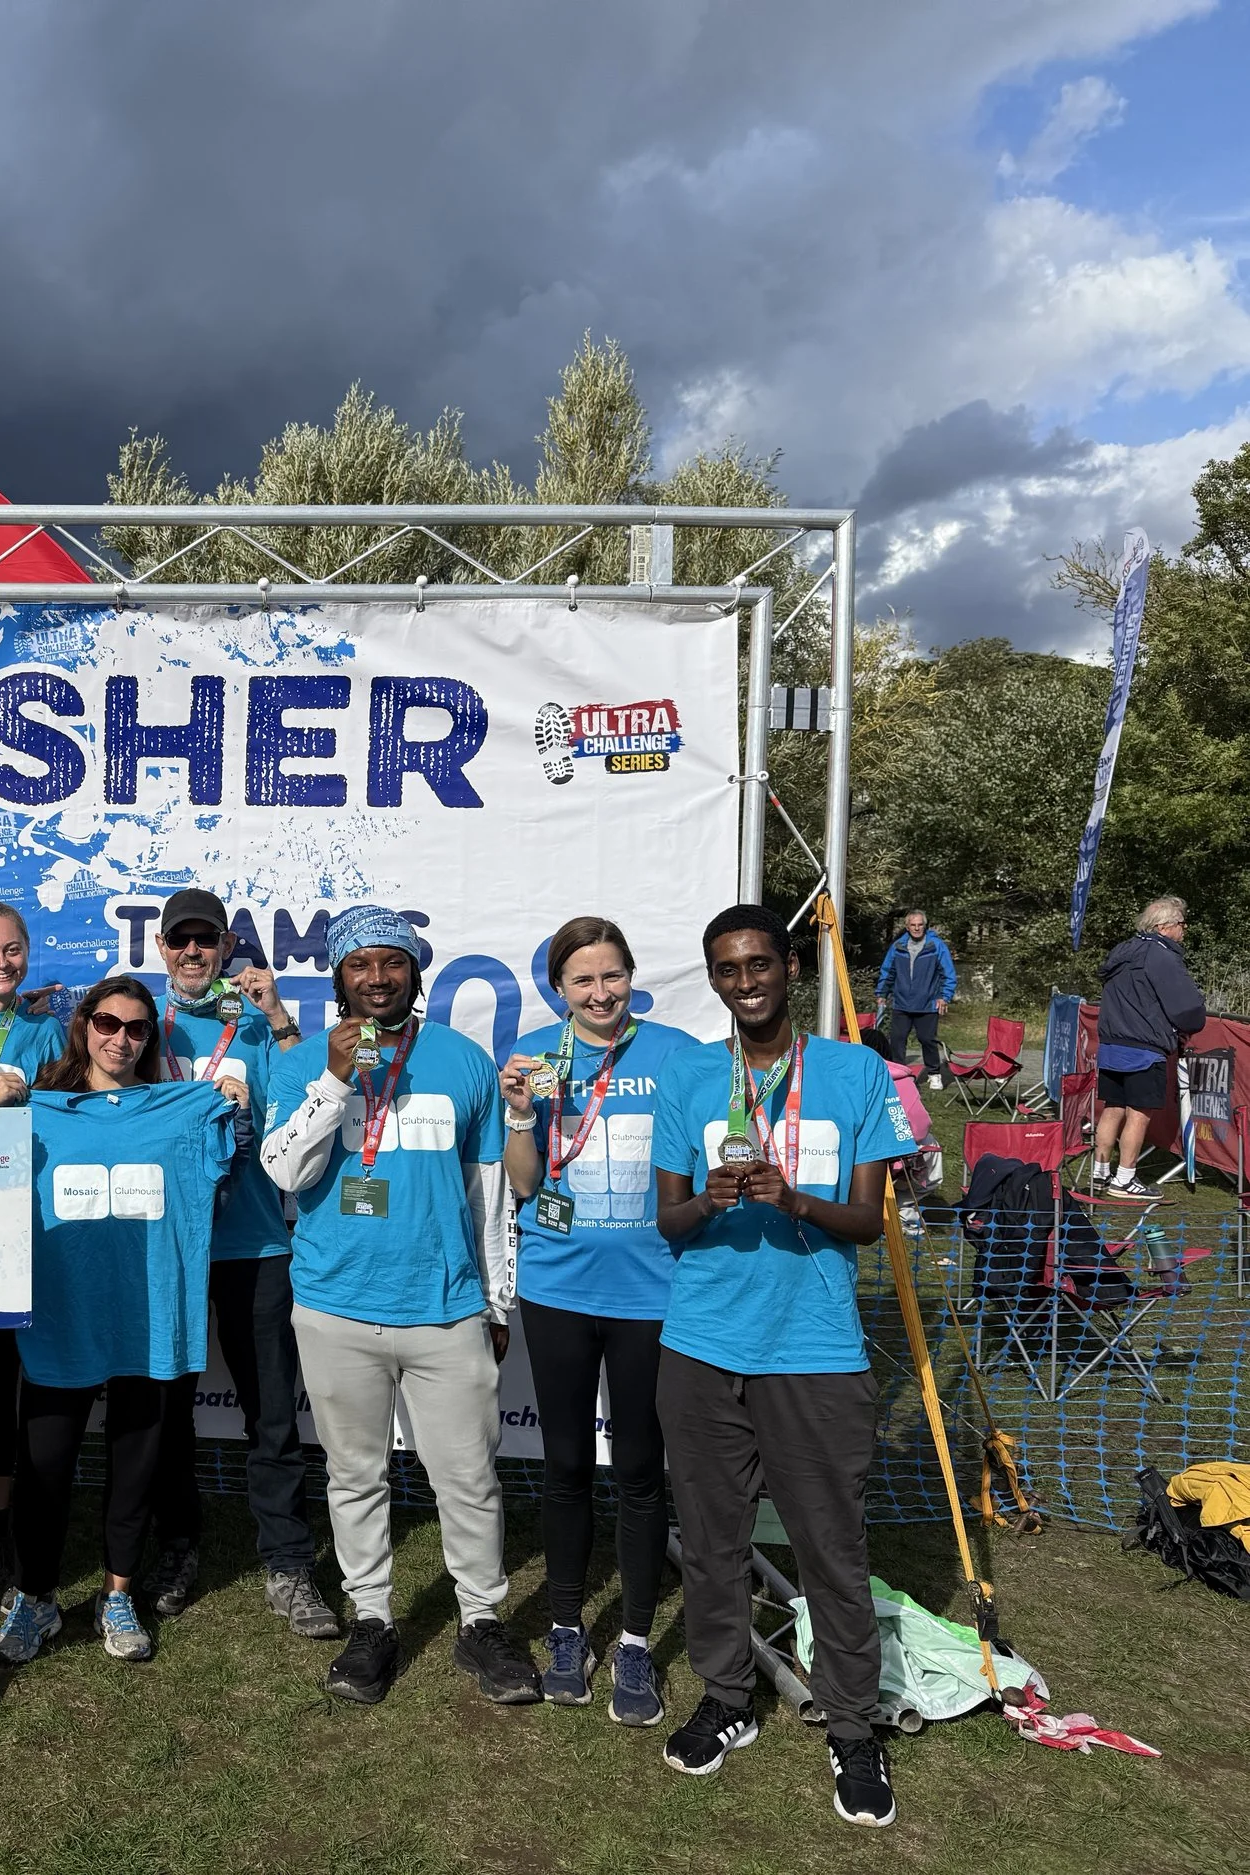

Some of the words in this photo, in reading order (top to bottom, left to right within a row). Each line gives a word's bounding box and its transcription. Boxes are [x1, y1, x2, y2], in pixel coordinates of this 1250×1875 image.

[581, 707, 672, 737] ULTRA
[611, 754, 665, 772] SERIES
[56, 936, 120, 951] actionchallenge
[114, 905, 434, 972] TAMS
[1188, 1056, 1230, 1094] LTRA
[401, 1117, 452, 1127] Clubhouse
[574, 1168, 601, 1176] Mosaic
[63, 1187, 99, 1196] Mosaic
[114, 1187, 162, 1196] Clubhouse
[572, 1218, 598, 1228] Health
[599, 1219, 633, 1230] Support
